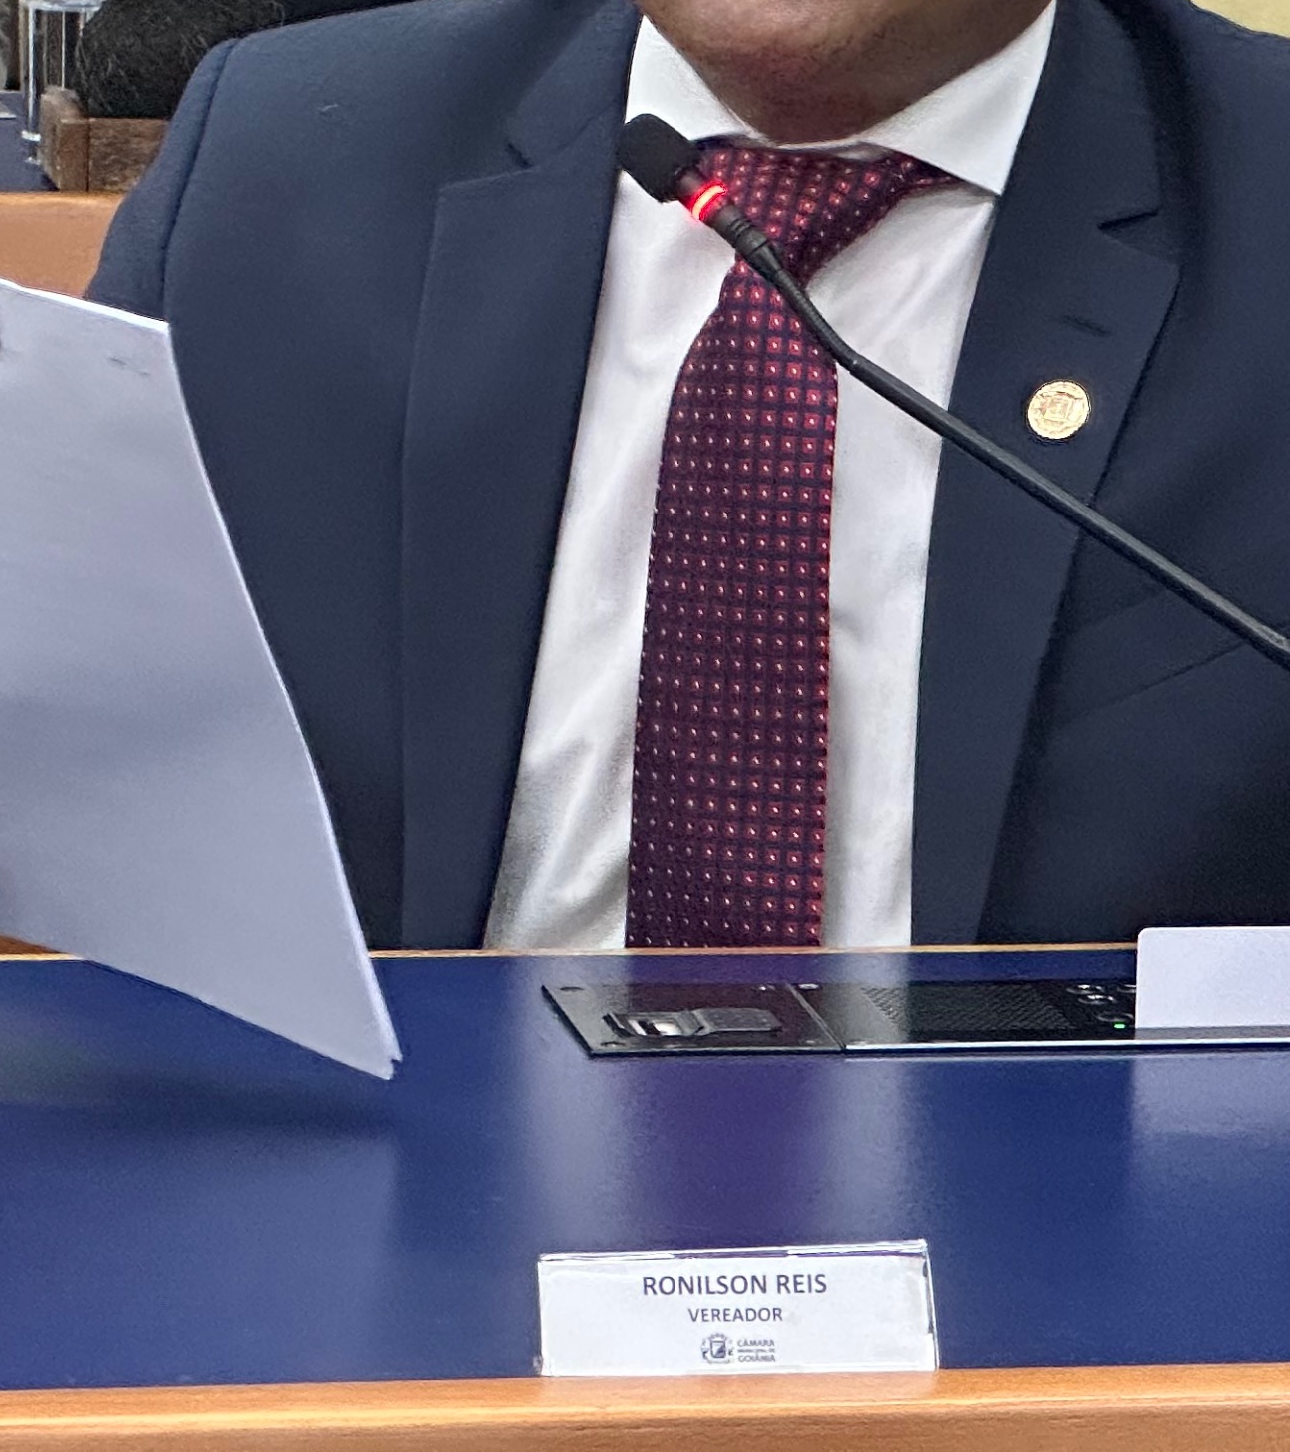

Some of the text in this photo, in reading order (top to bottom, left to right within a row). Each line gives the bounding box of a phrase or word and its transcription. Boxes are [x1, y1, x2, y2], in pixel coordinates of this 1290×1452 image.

[643, 1274, 827, 1296] RONILSON REIS
[688, 1308, 783, 1322] VEREADOR
